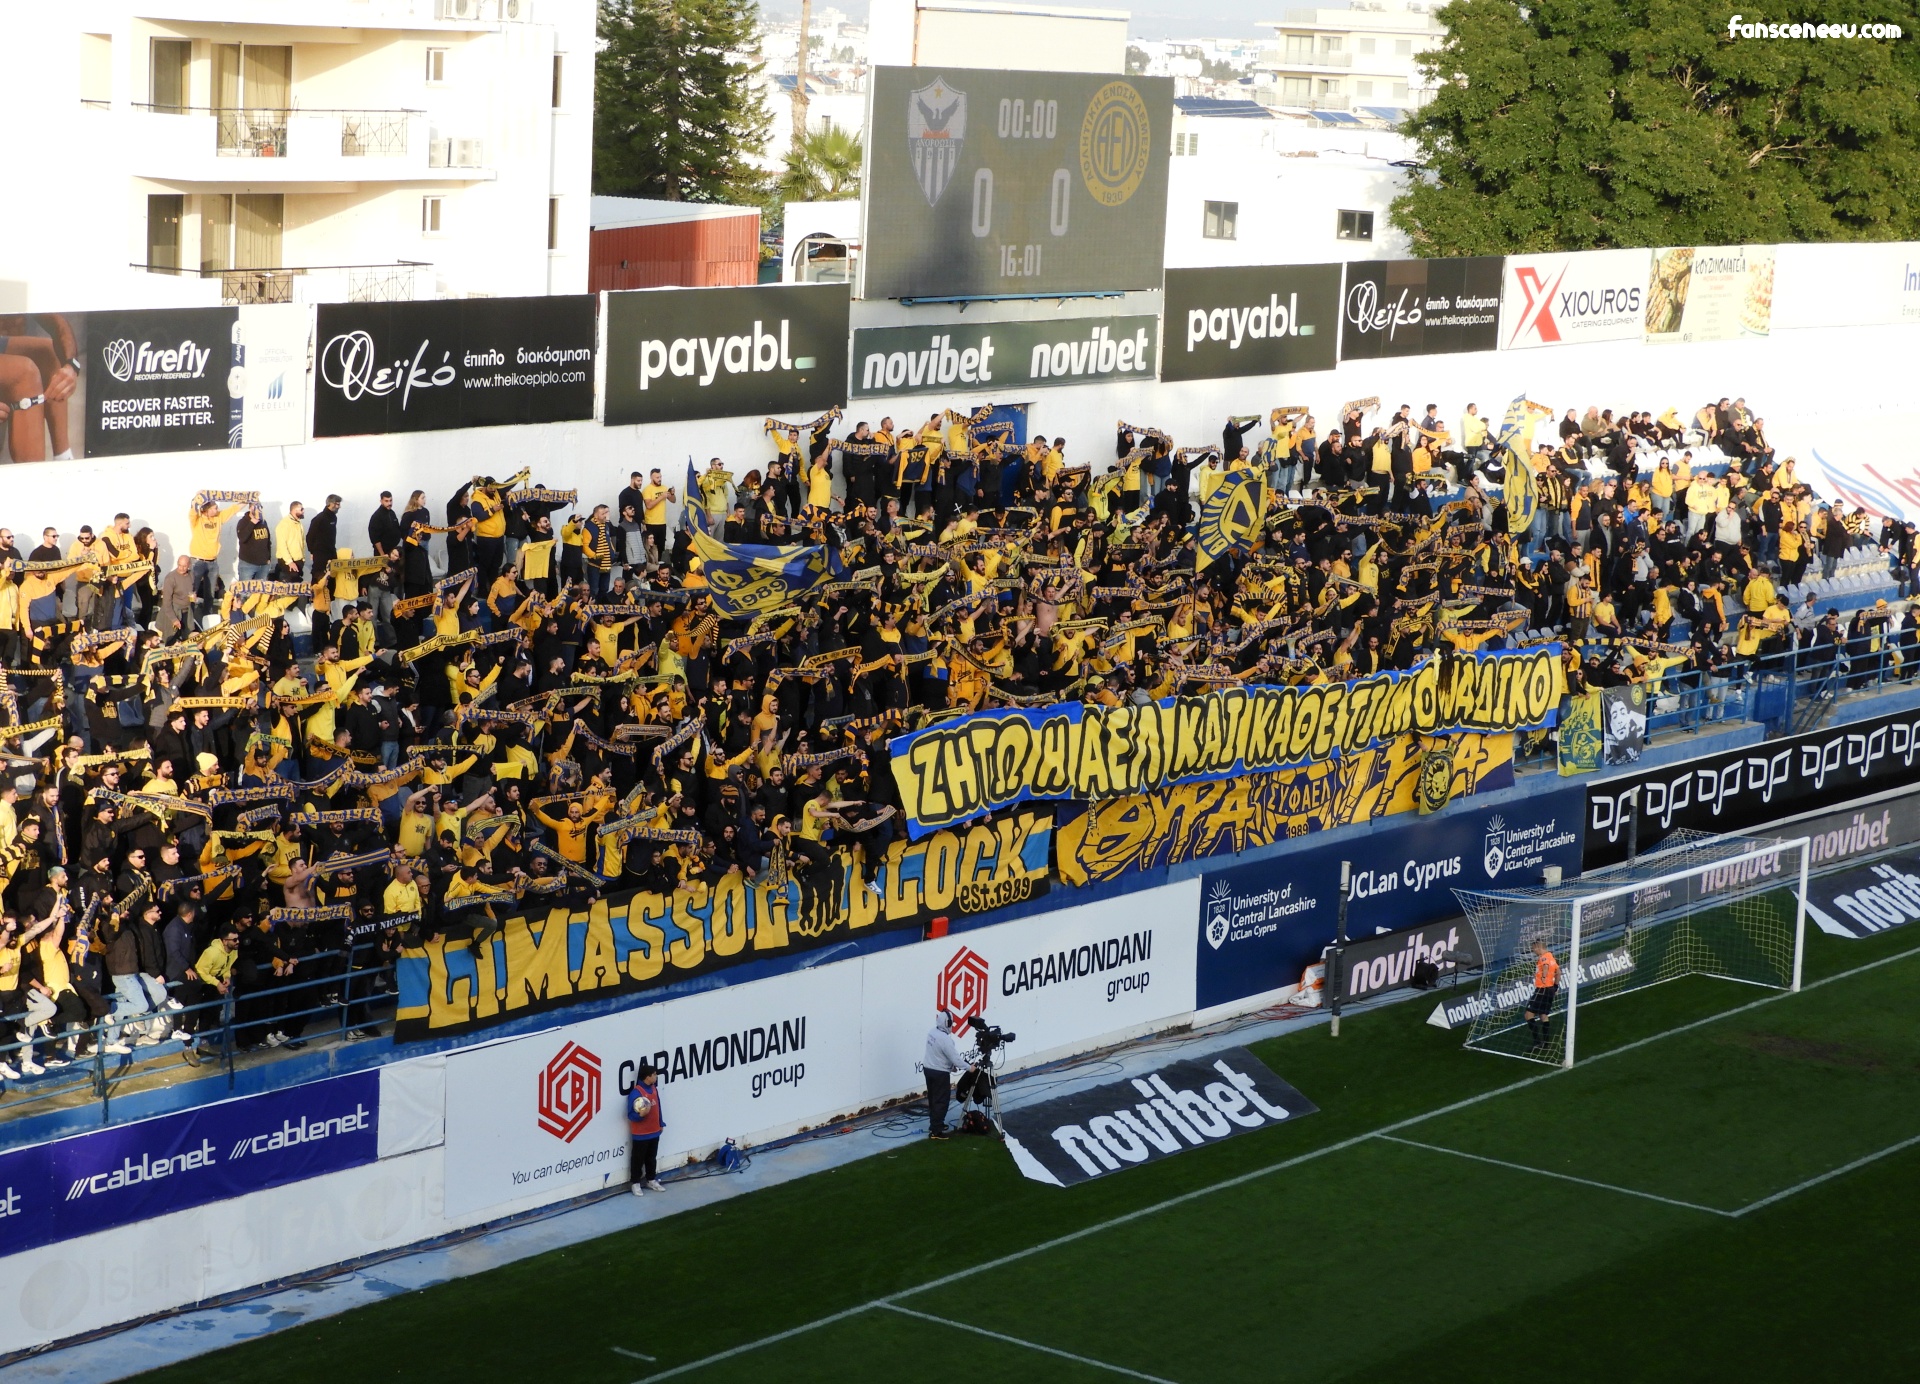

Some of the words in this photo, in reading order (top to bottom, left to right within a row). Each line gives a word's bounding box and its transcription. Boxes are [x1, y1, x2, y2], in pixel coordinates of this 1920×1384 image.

[998, 98, 1058, 139] 00:00
[971, 168, 993, 237] 0
[1050, 168, 1071, 236] 0
[1000, 244, 1042, 277] 16:01
[1559, 287, 1641, 318] XIOUROS
[1571, 318, 1602, 329] CATERING
[1602, 316, 1639, 327] EQUIPMENT
[136, 340, 211, 378] firefly
[464, 349, 505, 368] έπιπλο
[516, 346, 591, 367] διακόσμηση
[862, 334, 996, 391] novibet
[1030, 327, 1149, 379] novibet
[134, 373, 162, 381] RECOVERY
[162, 372, 191, 380] REDEFINED
[464, 371, 586, 389] www.theikoepiplo.com
[101, 414, 161, 430] PERFORM
[164, 411, 215, 427] BETTER.
[102, 398, 161, 414] RECOVER
[164, 395, 213, 411] FASTER.
[112, 564, 123, 572] WE
[126, 562, 139, 570] ARE
[728, 577, 788, 611] 1989
[910, 714, 1033, 827] ΖΗΤΩ
[1031, 716, 1070, 794] Η
[1076, 702, 1163, 799] ΑΕΛ
[1168, 688, 1248, 779] ΚΑΙ
[1244, 680, 1348, 768] ΚΑΘΕ
[1286, 824, 1309, 839] 1989
[1505, 840, 1534, 859] Central
[1535, 831, 1576, 852] Lancashire
[1506, 824, 1545, 844] University
[1546, 819, 1556, 834] of
[1811, 809, 1891, 863] novibet
[1403, 854, 1462, 892] Cyprus
[1504, 860, 1523, 872] UCLan
[1523, 856, 1543, 868] Cyprus
[958, 875, 1033, 914] est.1989
[1231, 905, 1266, 928] Central
[1268, 896, 1317, 919] Lancashire
[1233, 888, 1280, 911] University
[1281, 883, 1292, 900] of
[424, 869, 790, 1029] LIMASSOL
[849, 811, 1036, 930] BLOCK
[1230, 929, 1253, 942] UCLan
[1253, 923, 1278, 938] Cyprus
[1002, 929, 1153, 997] CARAMONDANI
[1349, 926, 1460, 996] novibet
[1107, 971, 1150, 1002] group
[1448, 993, 1494, 1024] novibet
[1497, 976, 1536, 1010] novibe
[1589, 949, 1633, 980] novibet
[752, 1062, 805, 1099] group
[251, 1102, 371, 1154] cablenet
[1050, 1058, 1290, 1178] novibet
[89, 1138, 217, 1195] cablenet
[512, 1171, 532, 1186] You
[533, 1164, 553, 1180] can
[554, 1150, 596, 1174] depend
[596, 1149, 611, 1163] on
[612, 1145, 625, 1158] us
